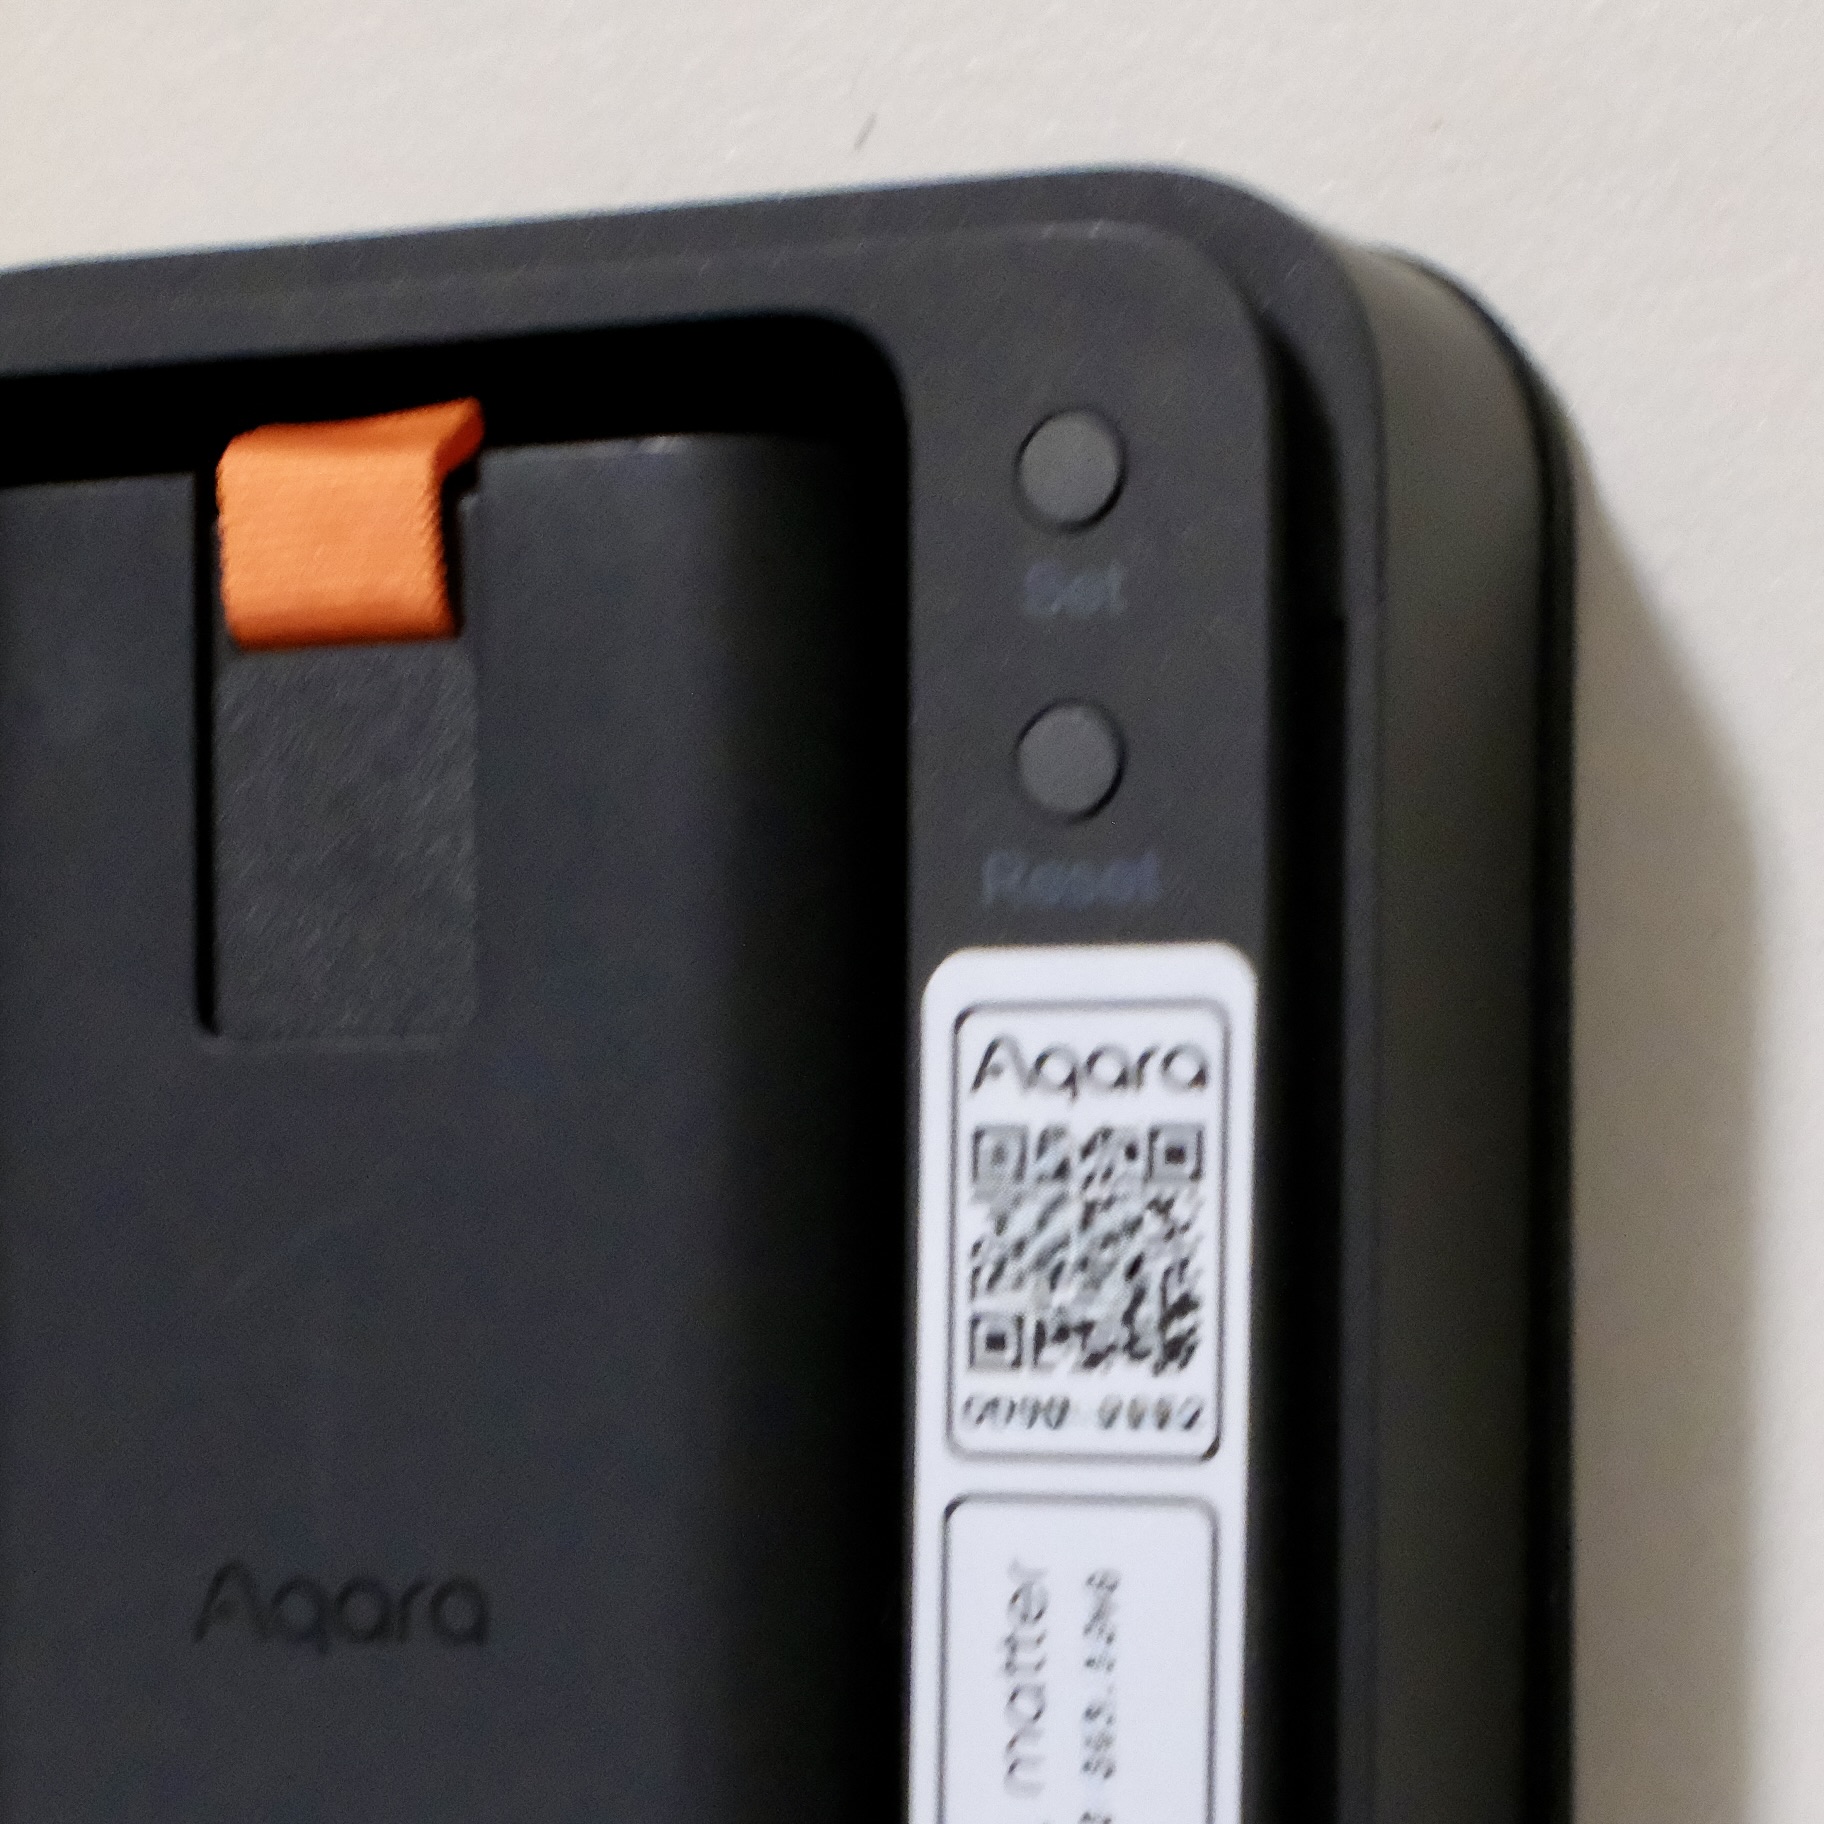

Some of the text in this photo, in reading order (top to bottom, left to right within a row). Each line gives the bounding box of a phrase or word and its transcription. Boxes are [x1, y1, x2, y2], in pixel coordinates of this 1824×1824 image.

[983, 850, 1161, 908] Reset
[972, 1034, 1208, 1102] Aqara
[192, 1560, 489, 1655] Aqara
[997, 1559, 1049, 1798] matter
